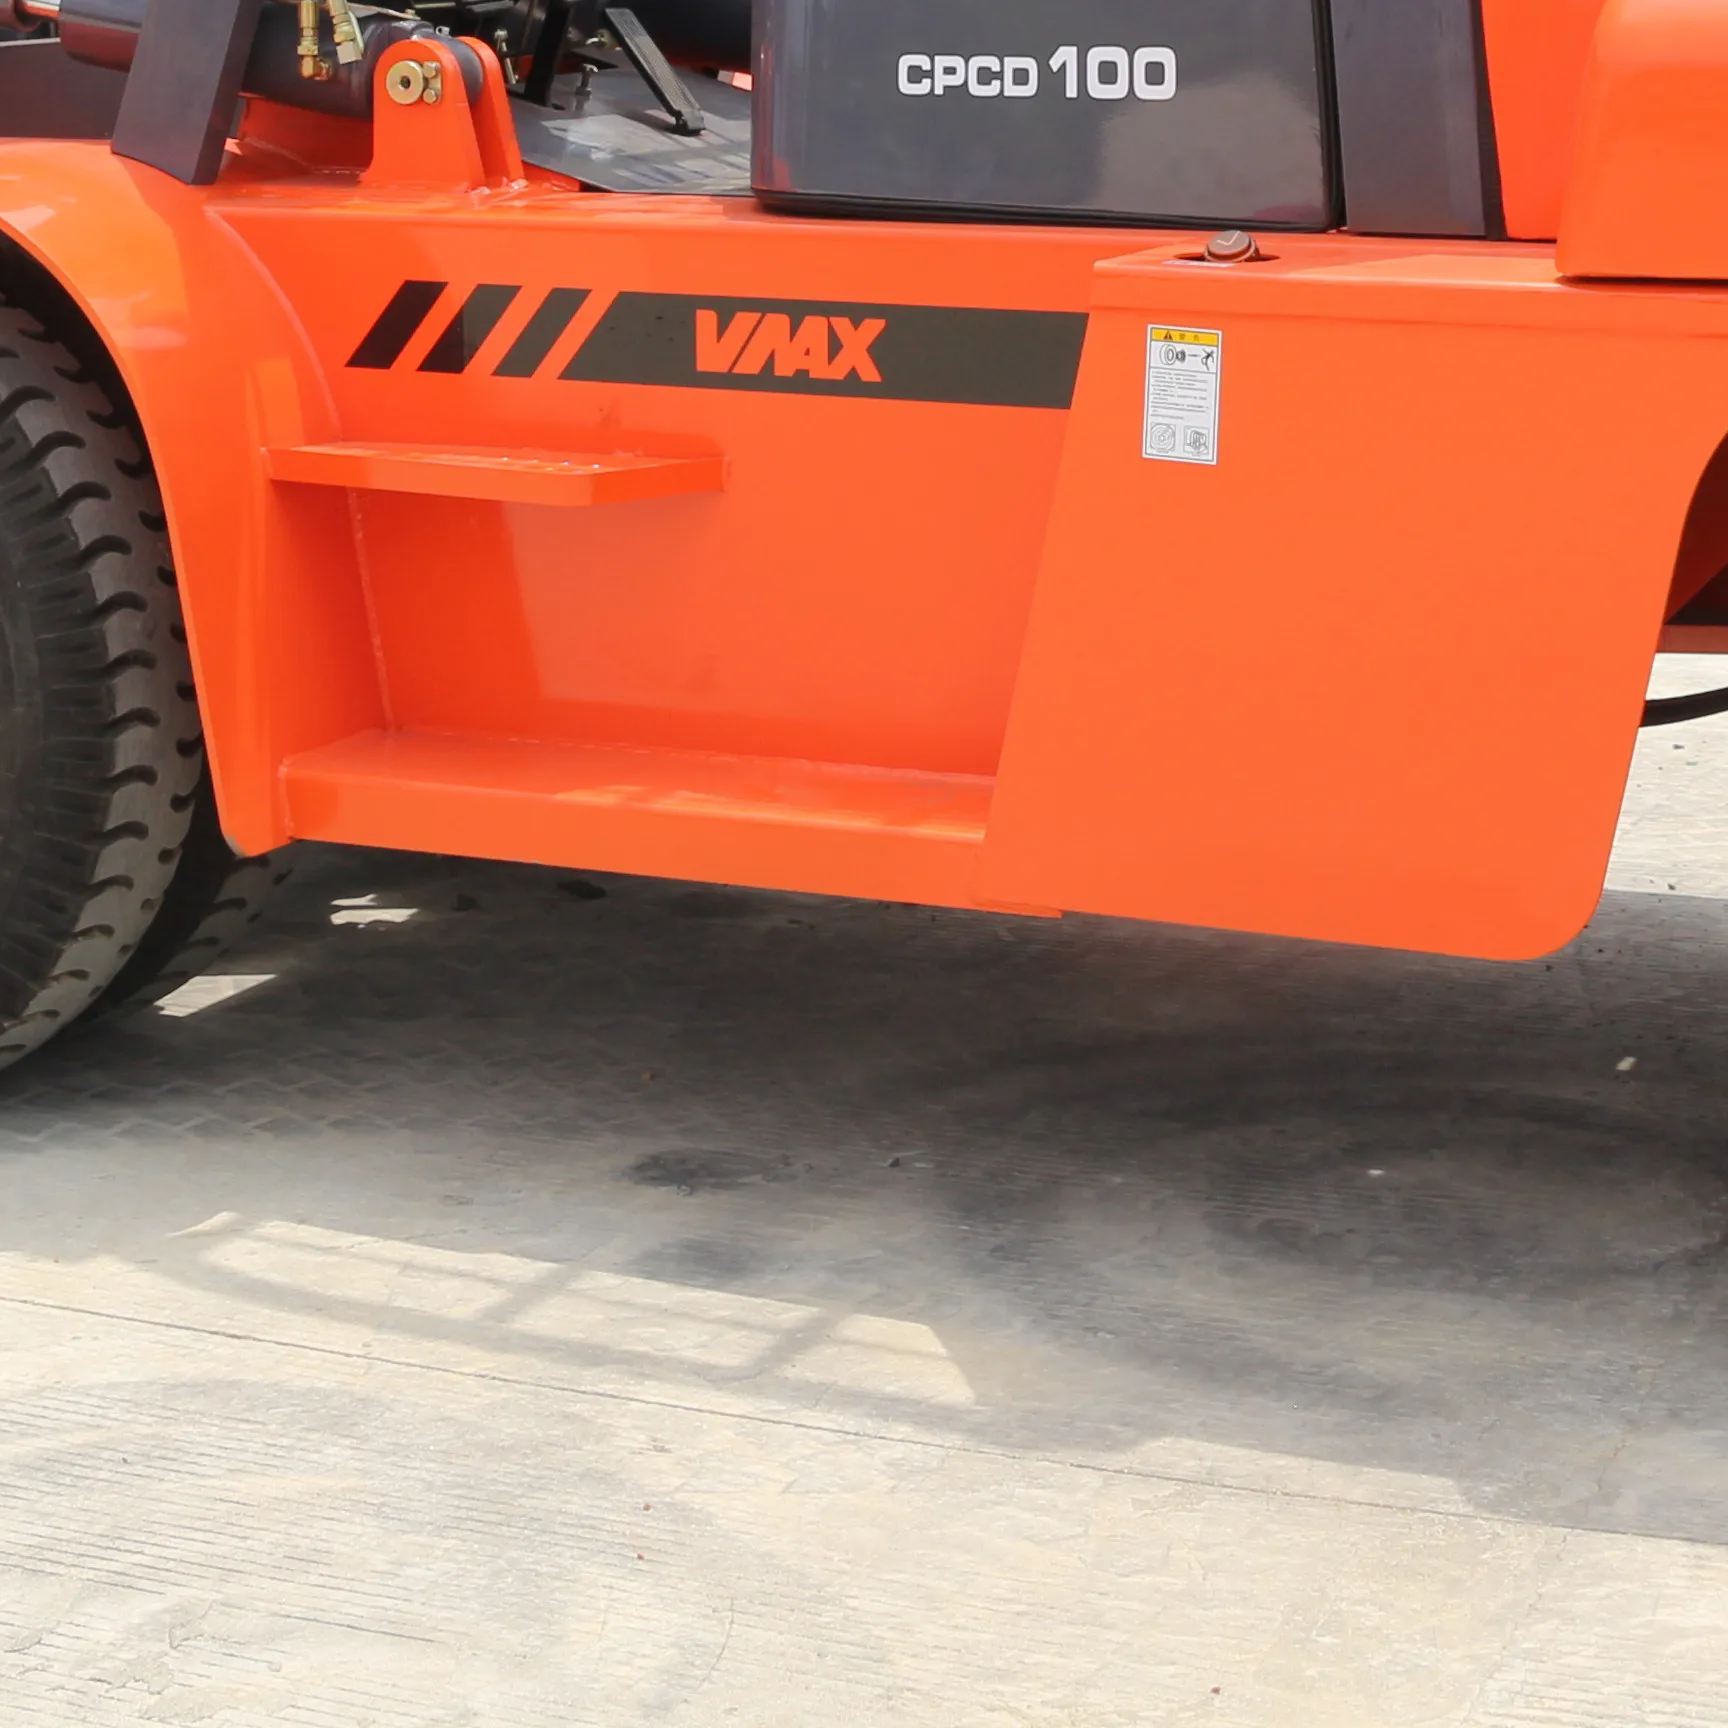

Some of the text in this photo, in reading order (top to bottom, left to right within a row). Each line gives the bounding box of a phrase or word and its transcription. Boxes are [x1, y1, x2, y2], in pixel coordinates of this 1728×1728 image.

[897, 45, 1178, 101] CPCD 100
[695, 308, 887, 383] VMAX
